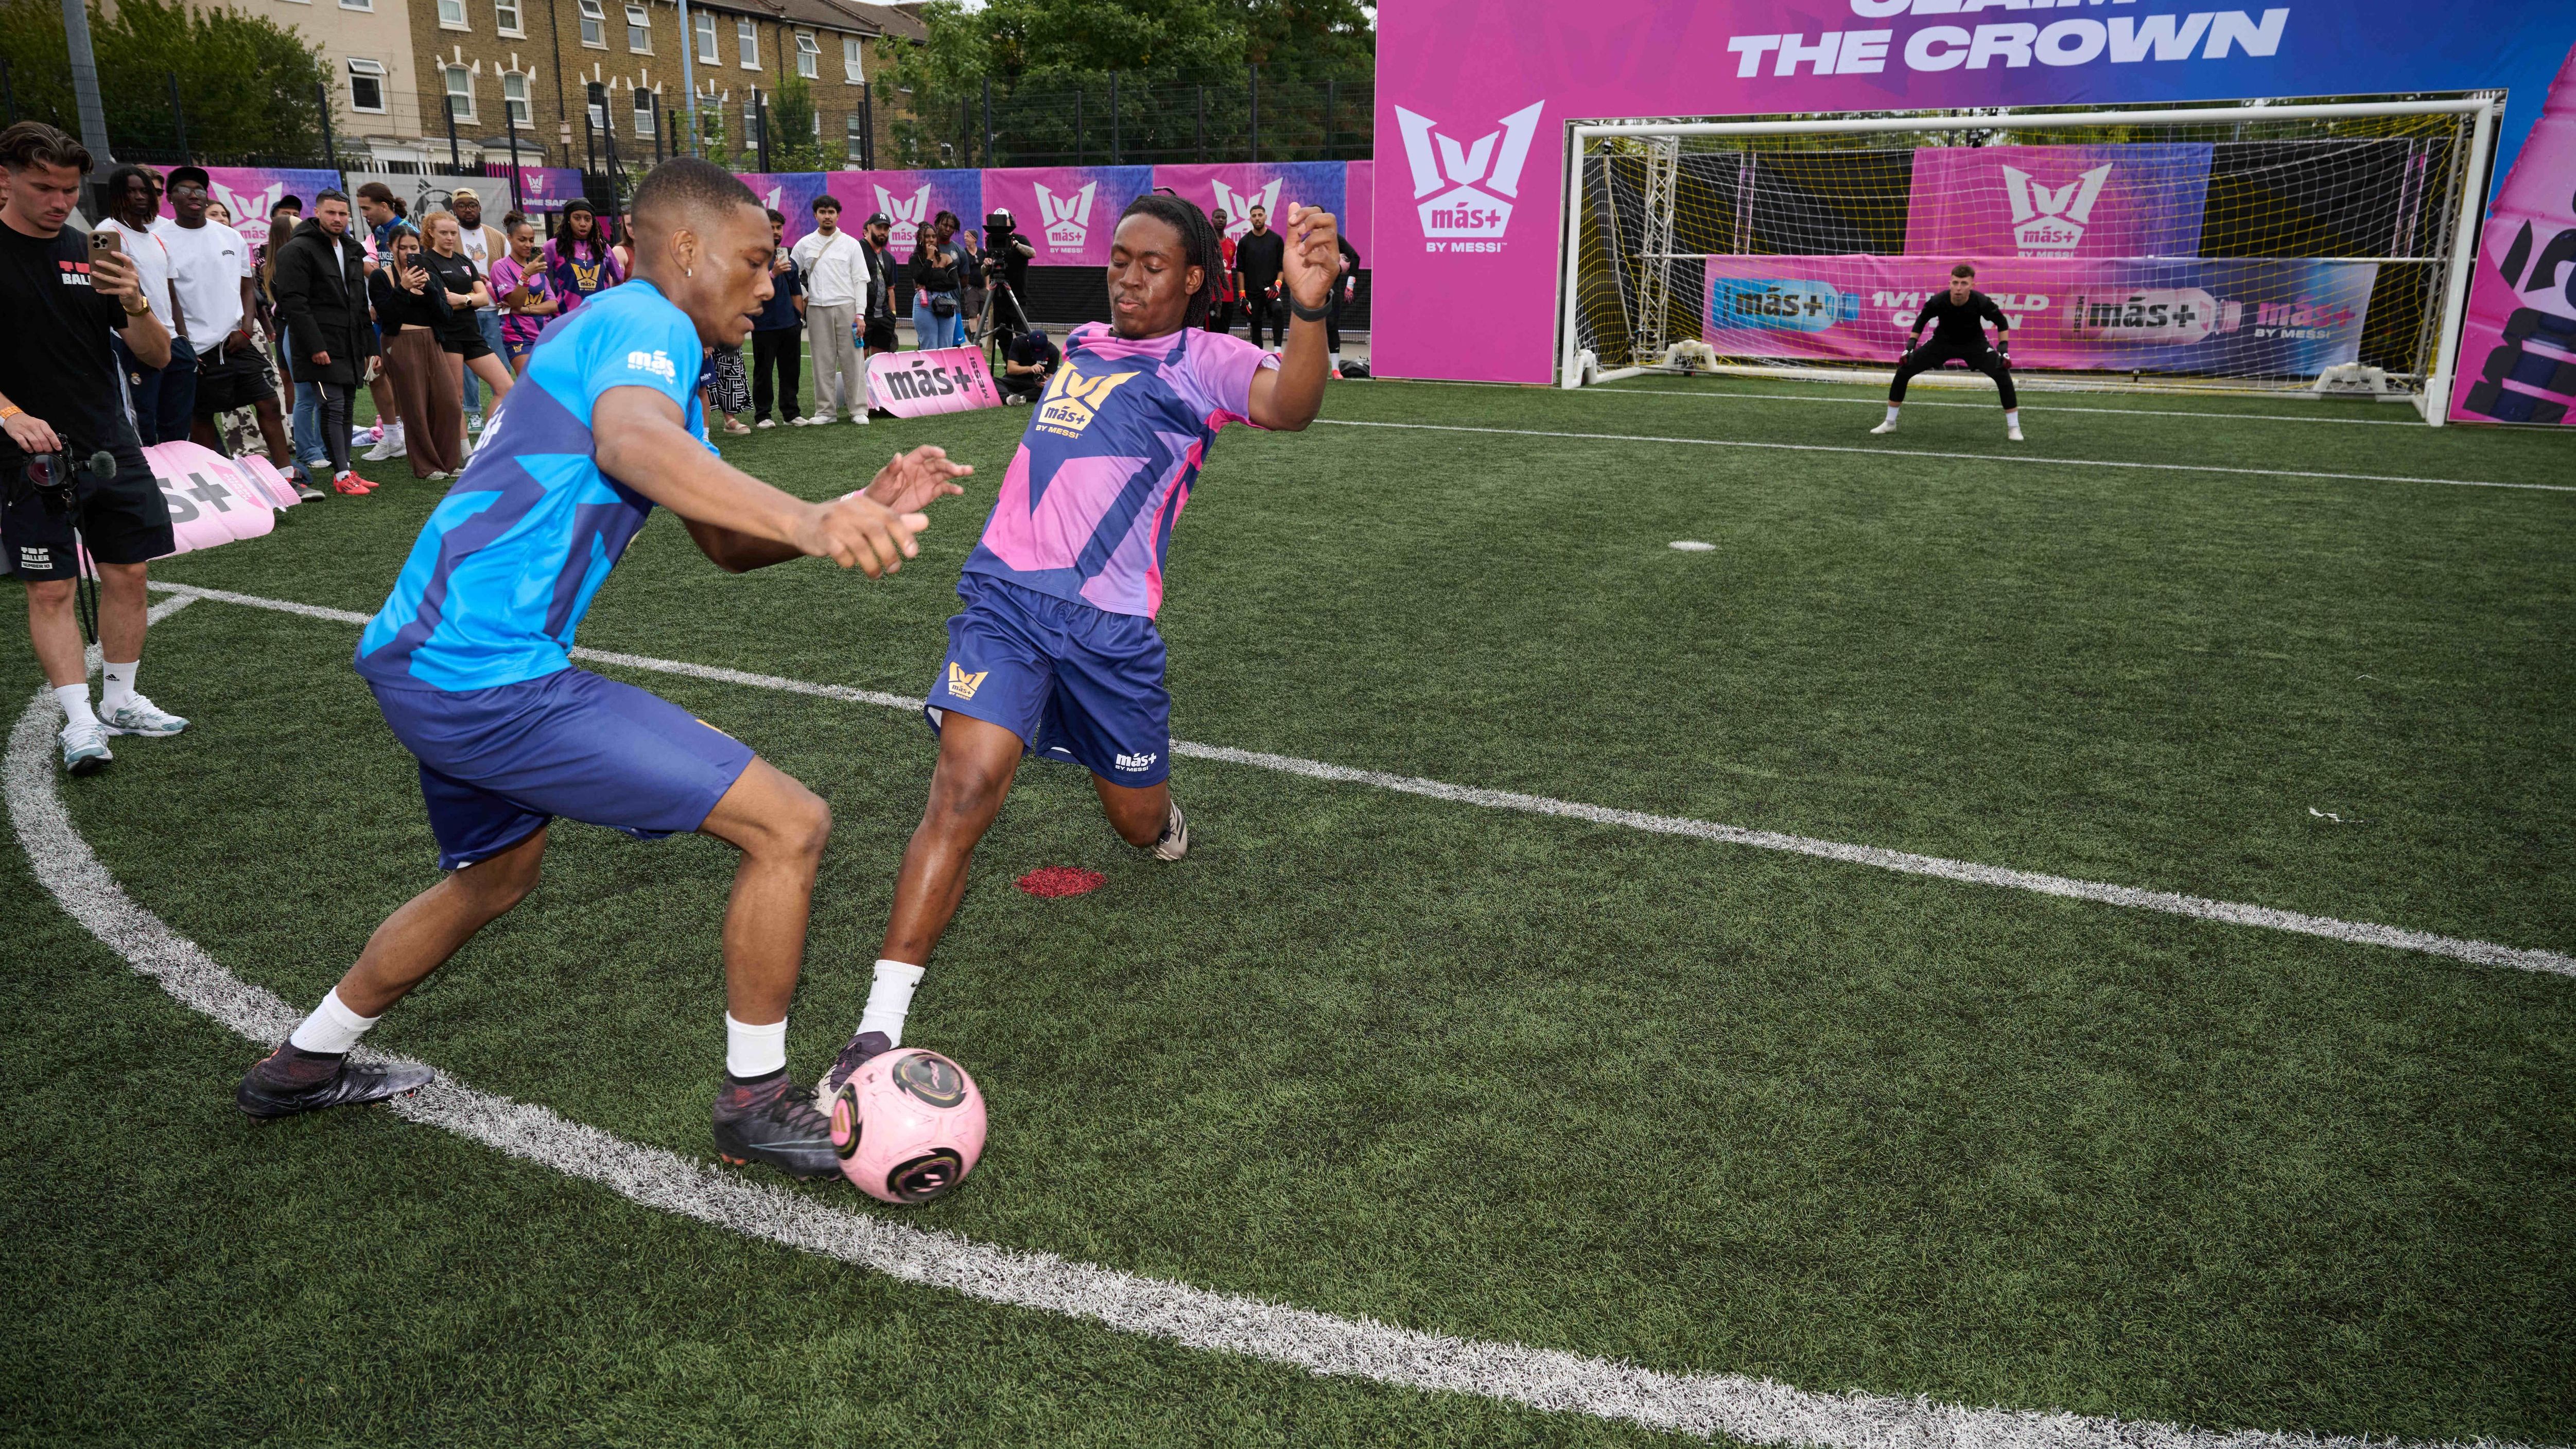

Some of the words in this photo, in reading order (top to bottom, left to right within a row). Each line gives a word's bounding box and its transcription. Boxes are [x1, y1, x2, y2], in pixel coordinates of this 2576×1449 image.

[1727, 29, 1892, 77] THE
[1904, 8, 2290, 72] CROWN
[1432, 202, 1501, 229] más+
[239, 226, 269, 239] más
[1052, 229, 1082, 241] más+
[2023, 225, 2075, 243] más+
[1426, 242, 1447, 252] BY
[59, 260, 91, 273] TO
[62, 273, 91, 285] BAL
[1736, 287, 1823, 317] más+
[1872, 291, 1920, 307] 1V1
[2088, 296, 2195, 327] más+
[2254, 328, 2276, 338] BY
[2281, 329, 2330, 339] MESSI
[884, 360, 972, 400] más+
[969, 357, 989, 398] MESSI
[1044, 406, 1086, 425] más+
[952, 685, 971, 695] más+
[1116, 753, 1156, 766] más+
